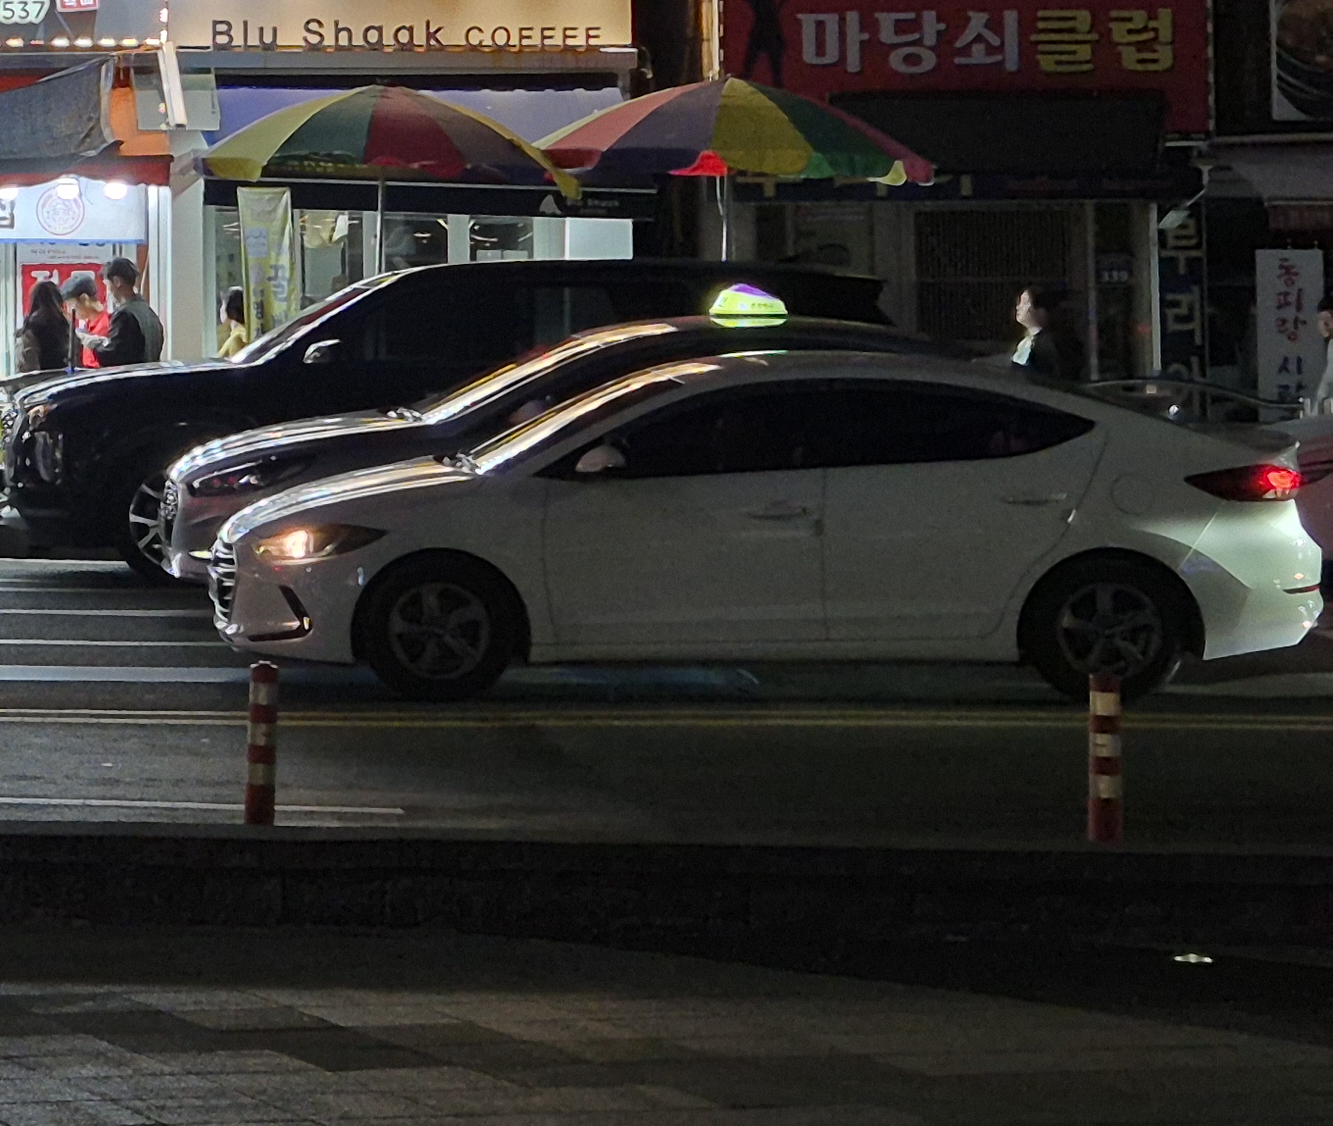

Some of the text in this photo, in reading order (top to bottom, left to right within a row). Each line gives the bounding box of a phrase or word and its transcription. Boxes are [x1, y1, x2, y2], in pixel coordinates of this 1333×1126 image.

[210, 17, 602, 49] Blu Shaak COFFEE
